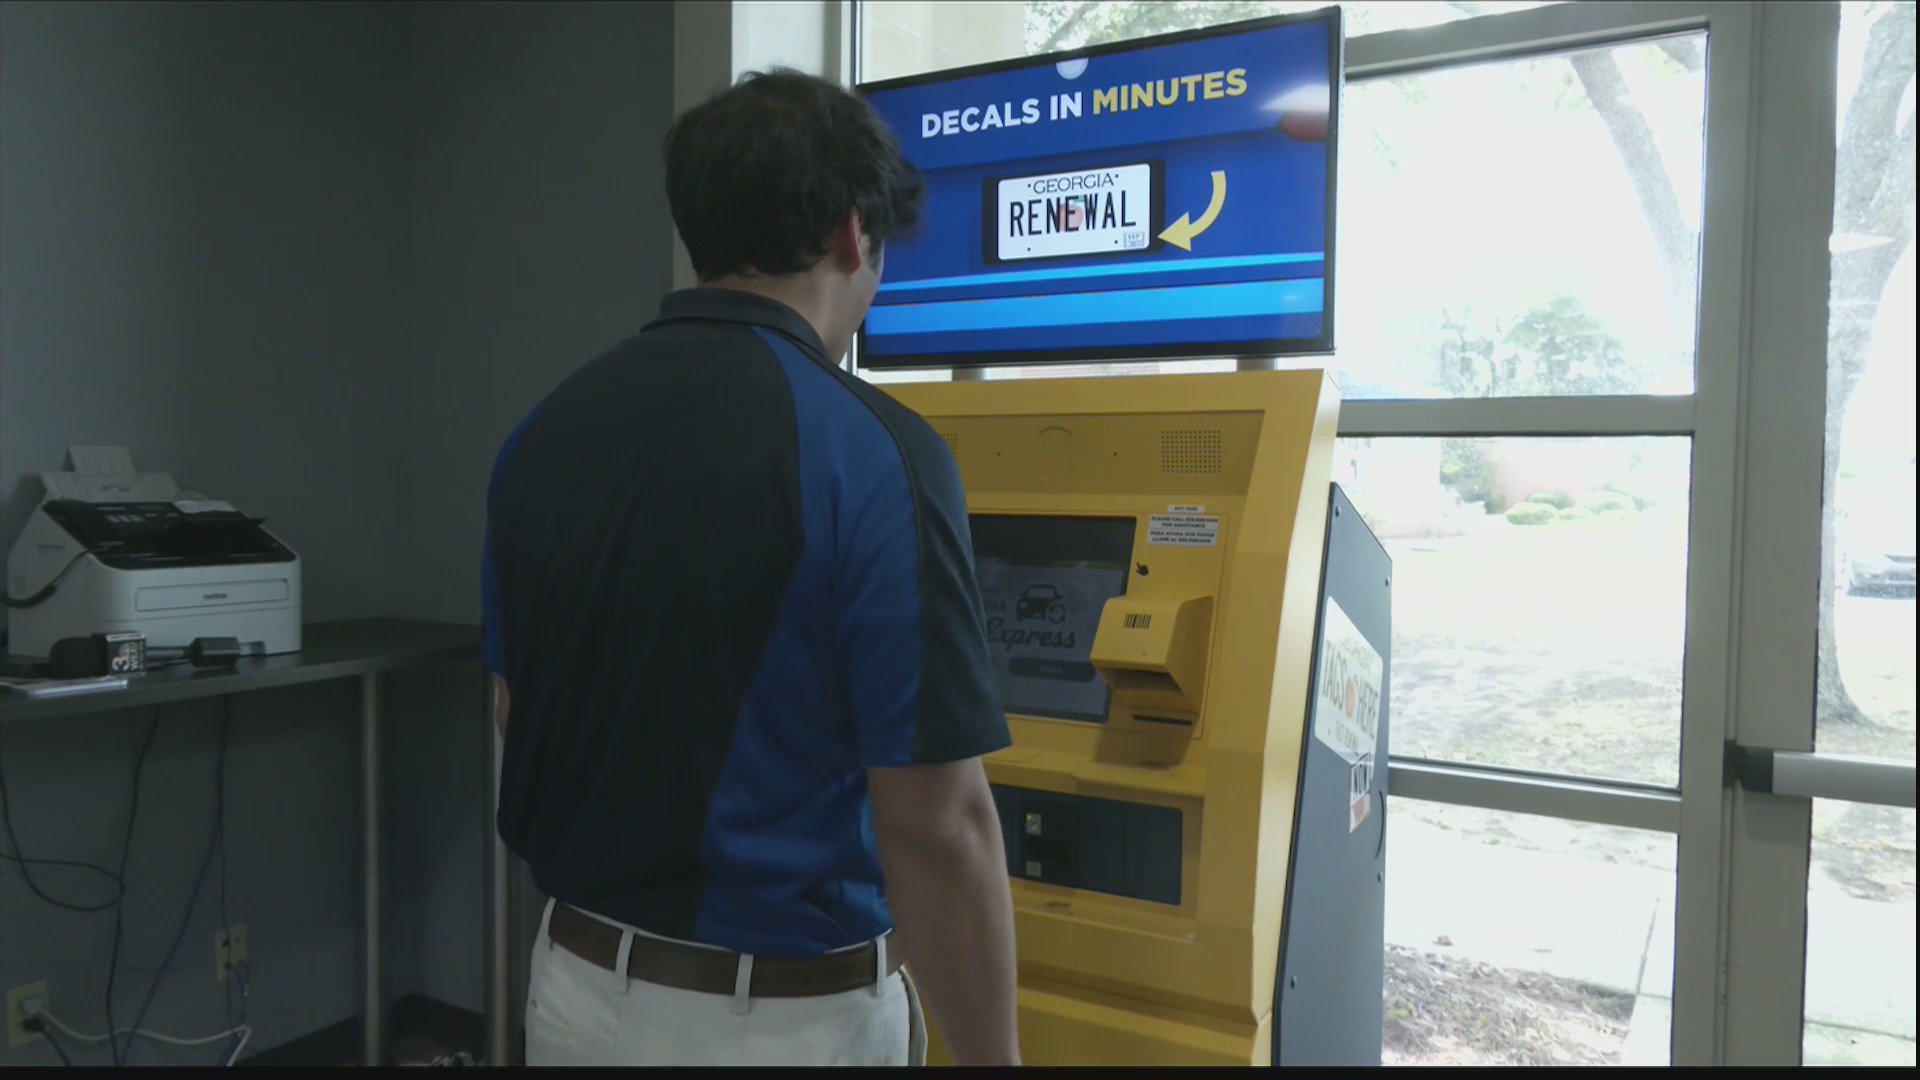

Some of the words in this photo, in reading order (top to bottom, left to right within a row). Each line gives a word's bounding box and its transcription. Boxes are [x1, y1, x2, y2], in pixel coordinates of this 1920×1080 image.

[921, 98, 1040, 139] DECALS
[1050, 91, 1083, 121] IN
[1093, 68, 1248, 115] MINUTES
[1033, 173, 1115, 195] GEORGIA
[1010, 190, 1137, 237] RENEWAL
[987, 616, 1076, 652] Express
[112, 655, 130, 671] 3
[1321, 639, 1348, 711] TAGS
[1356, 678, 1380, 741] HERE
